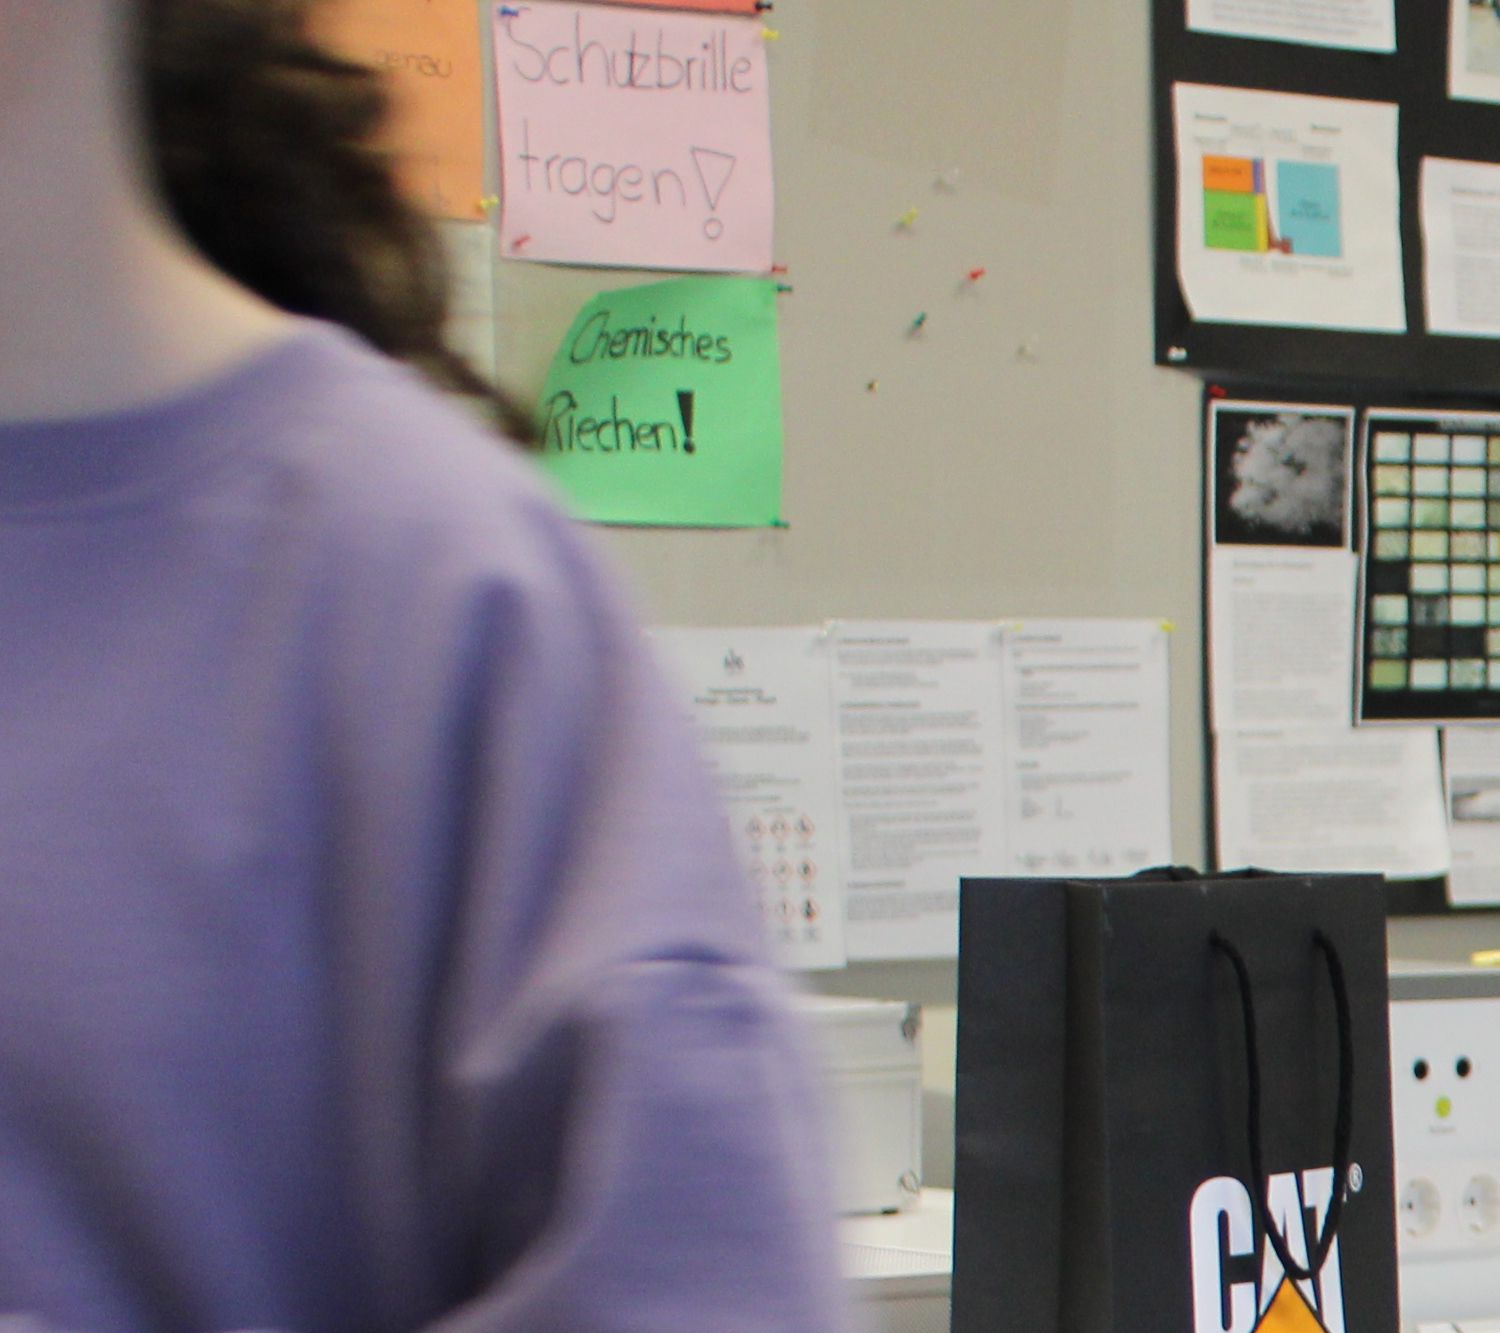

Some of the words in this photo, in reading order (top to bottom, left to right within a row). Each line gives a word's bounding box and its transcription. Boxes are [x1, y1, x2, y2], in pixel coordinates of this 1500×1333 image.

[505, 8, 752, 93] Schutzbrille
[569, 309, 732, 365] Chemisches
[543, 390, 696, 454] Riechen!
